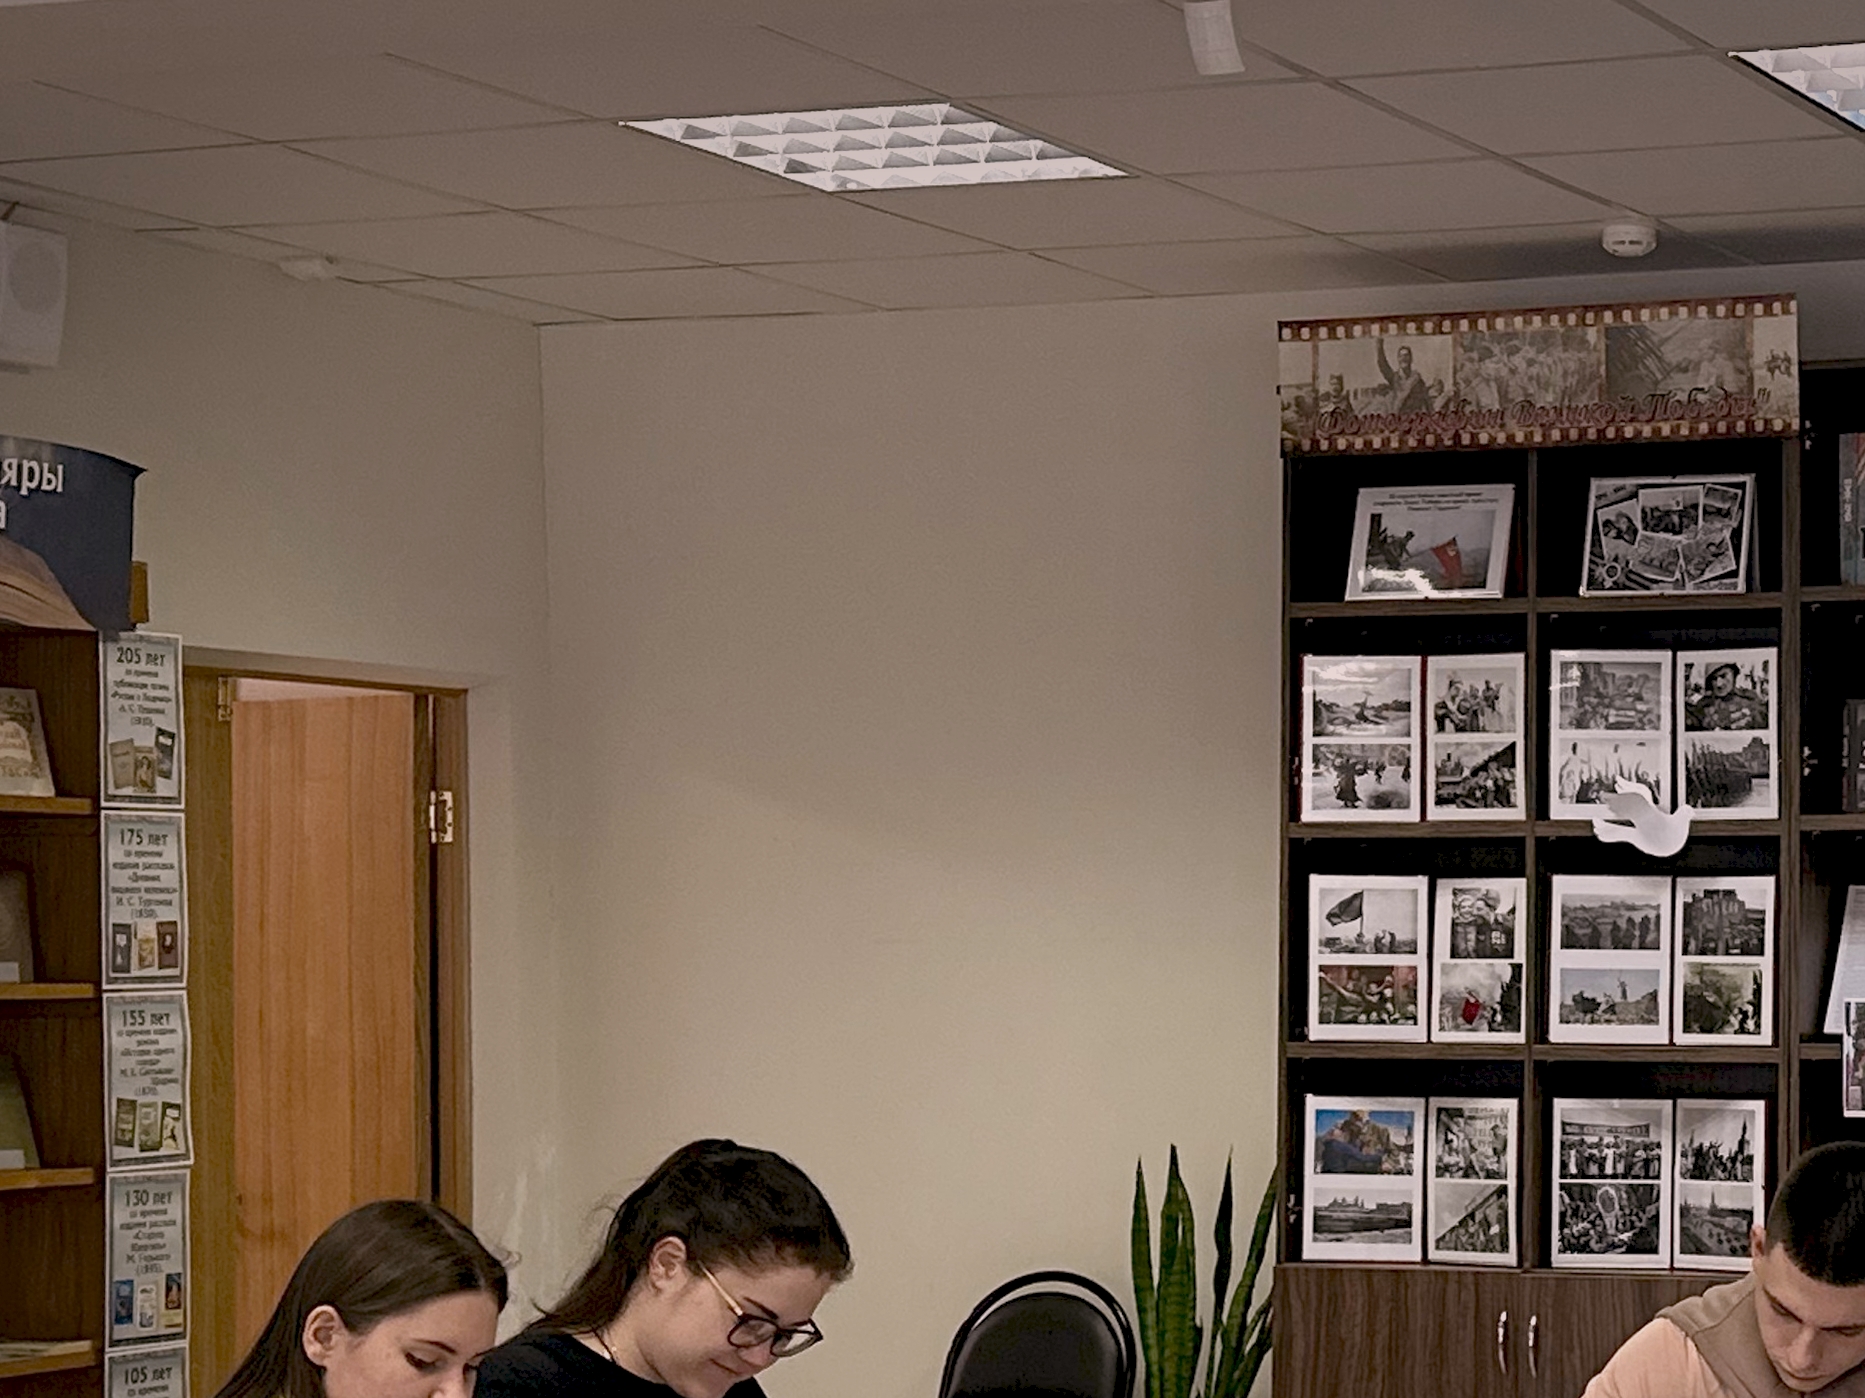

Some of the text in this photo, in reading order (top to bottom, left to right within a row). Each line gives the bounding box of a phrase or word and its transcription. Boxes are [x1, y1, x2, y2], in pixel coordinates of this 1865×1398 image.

[1315, 399, 1505, 438] Фотографии
[1511, 393, 1637, 428] Великой
[116, 646, 142, 664] 205
[119, 828, 143, 846] 175
[121, 1009, 146, 1027] 155
[124, 1189, 149, 1207] 130
[124, 1366, 148, 1385] 105
